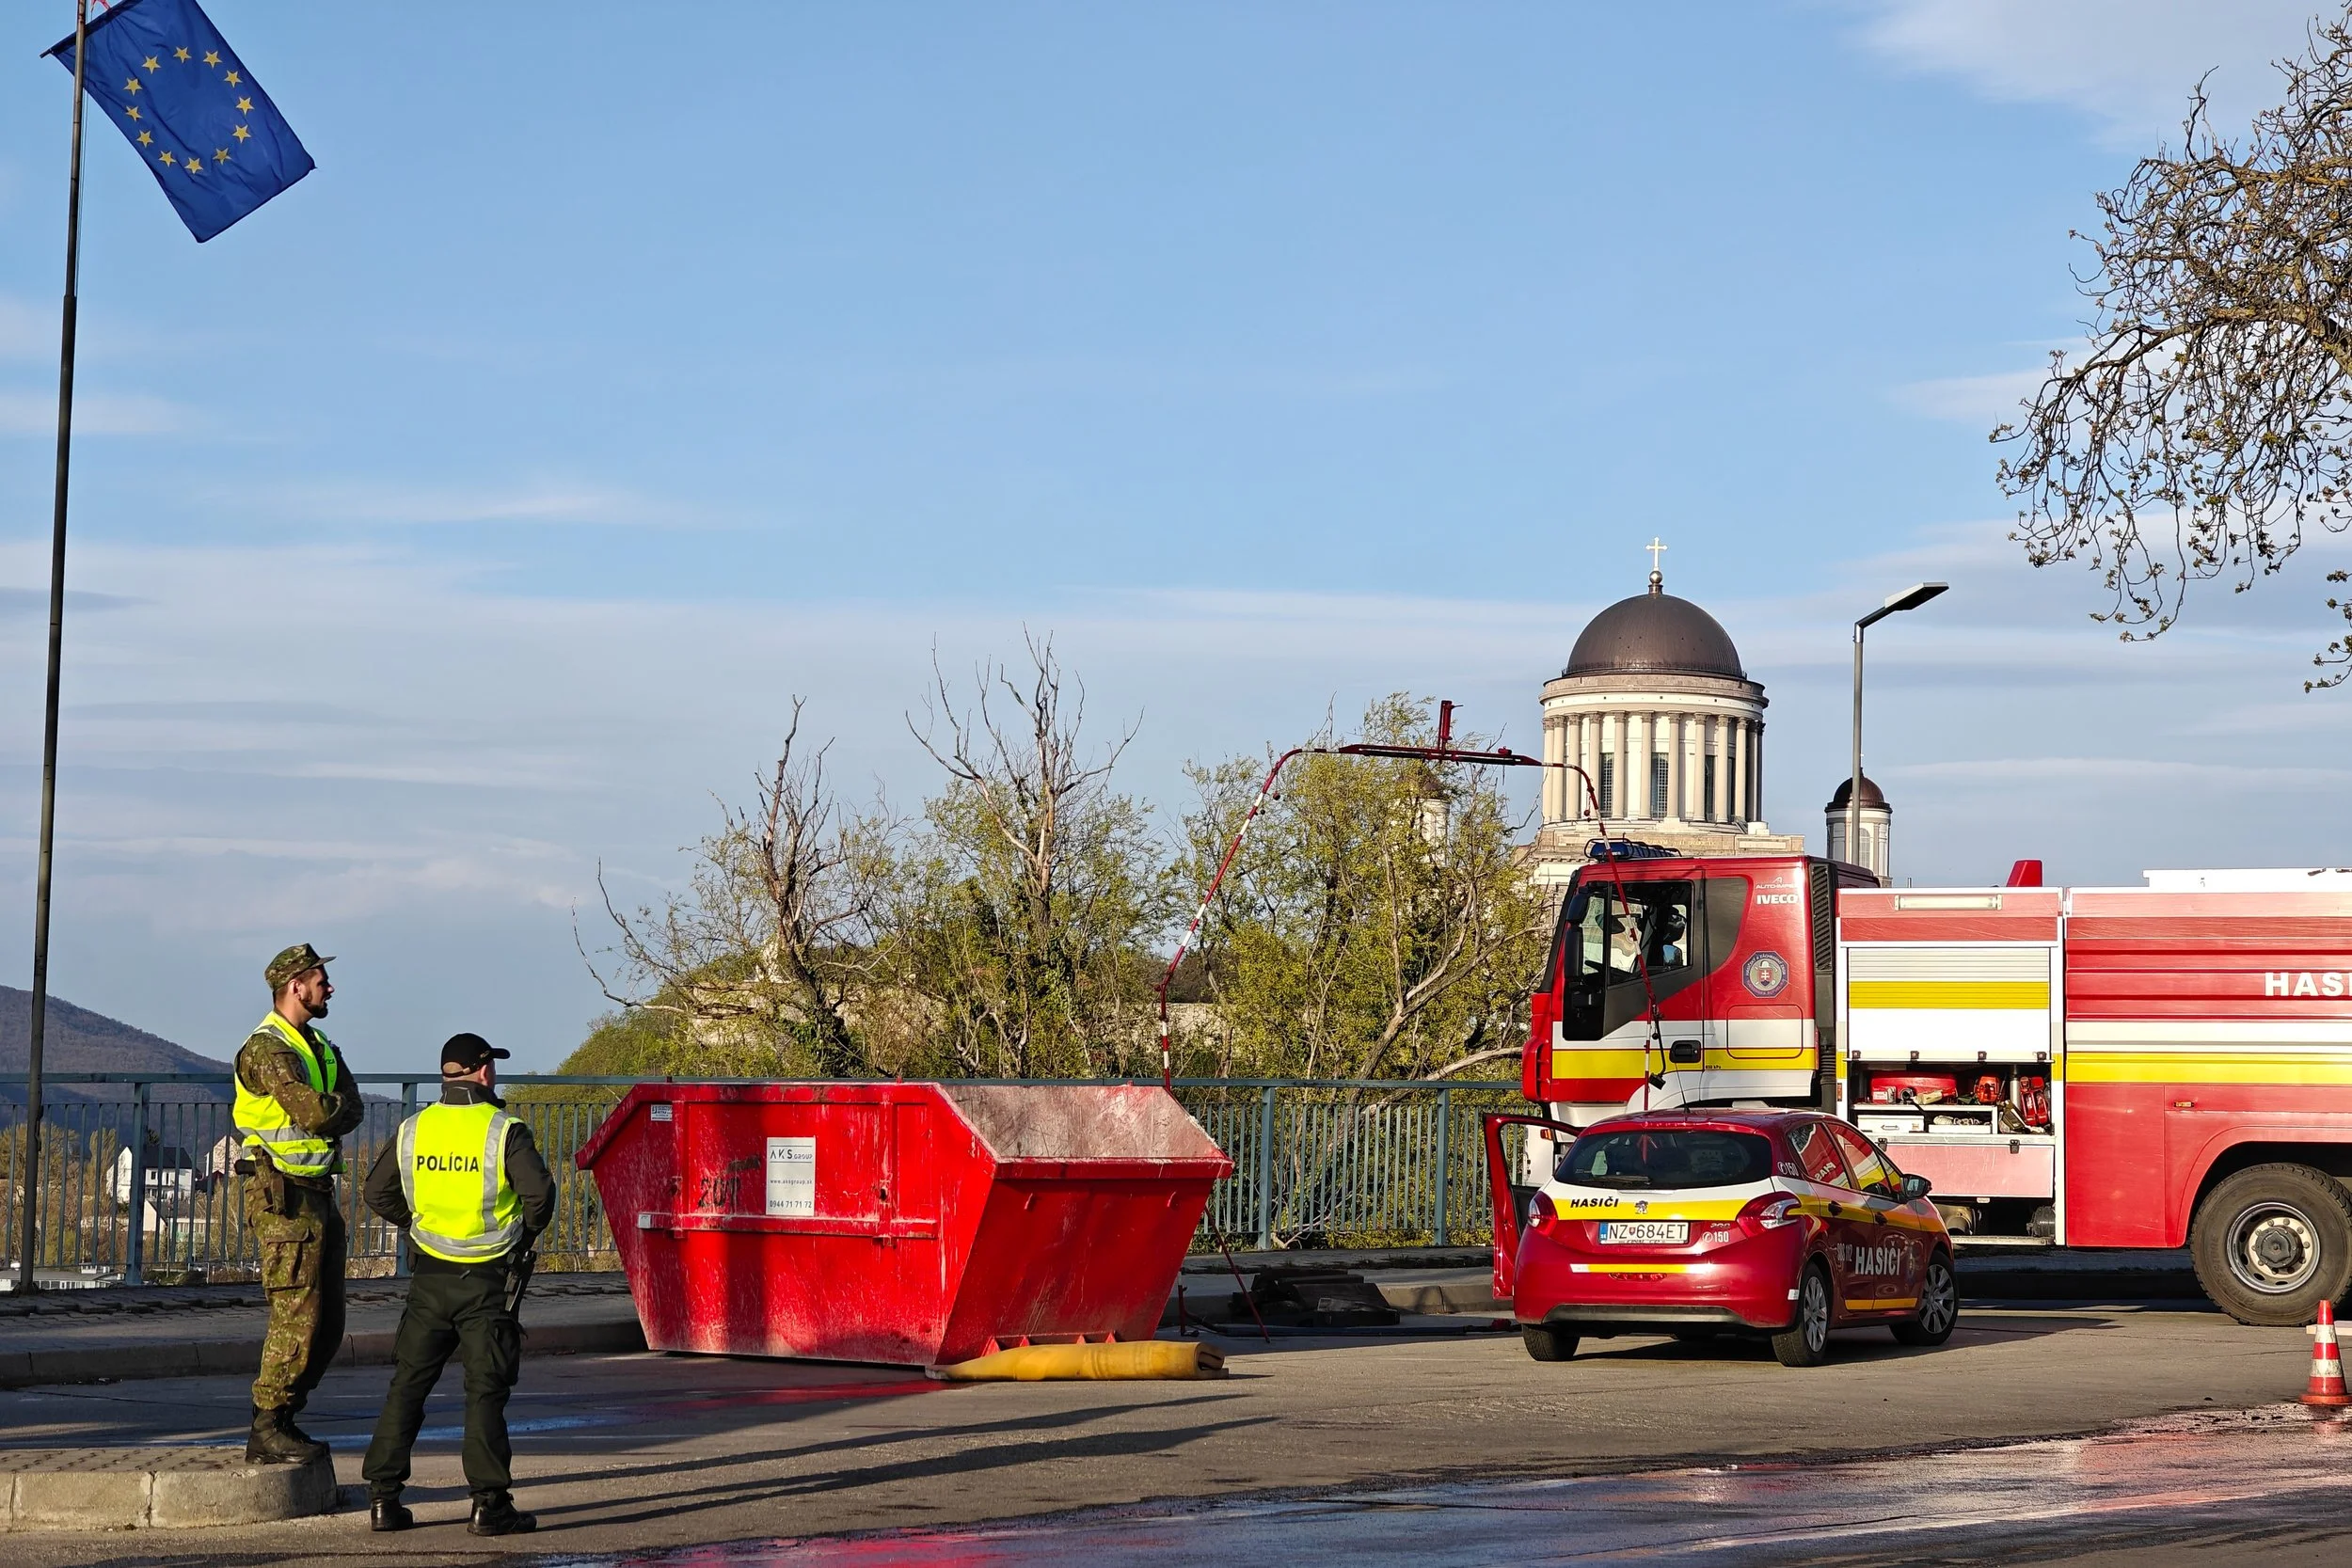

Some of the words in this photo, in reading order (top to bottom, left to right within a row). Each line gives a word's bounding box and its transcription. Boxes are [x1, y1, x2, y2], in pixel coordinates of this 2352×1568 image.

[1756, 894, 1799, 905] IVECO
[2265, 972, 2352, 996] HAS
[770, 1148, 793, 1160] AKS
[416, 1151, 479, 1172] POLÍCIA
[769, 1199, 785, 1209] 0944
[786, 1200, 793, 1209] 71
[794, 1200, 803, 1209] 71
[803, 1200, 812, 1209] 72
[1570, 1196, 1620, 1209] HASIČI
[1712, 1230, 1730, 1243] 150
[1854, 1240, 1901, 1275] HASIČI
